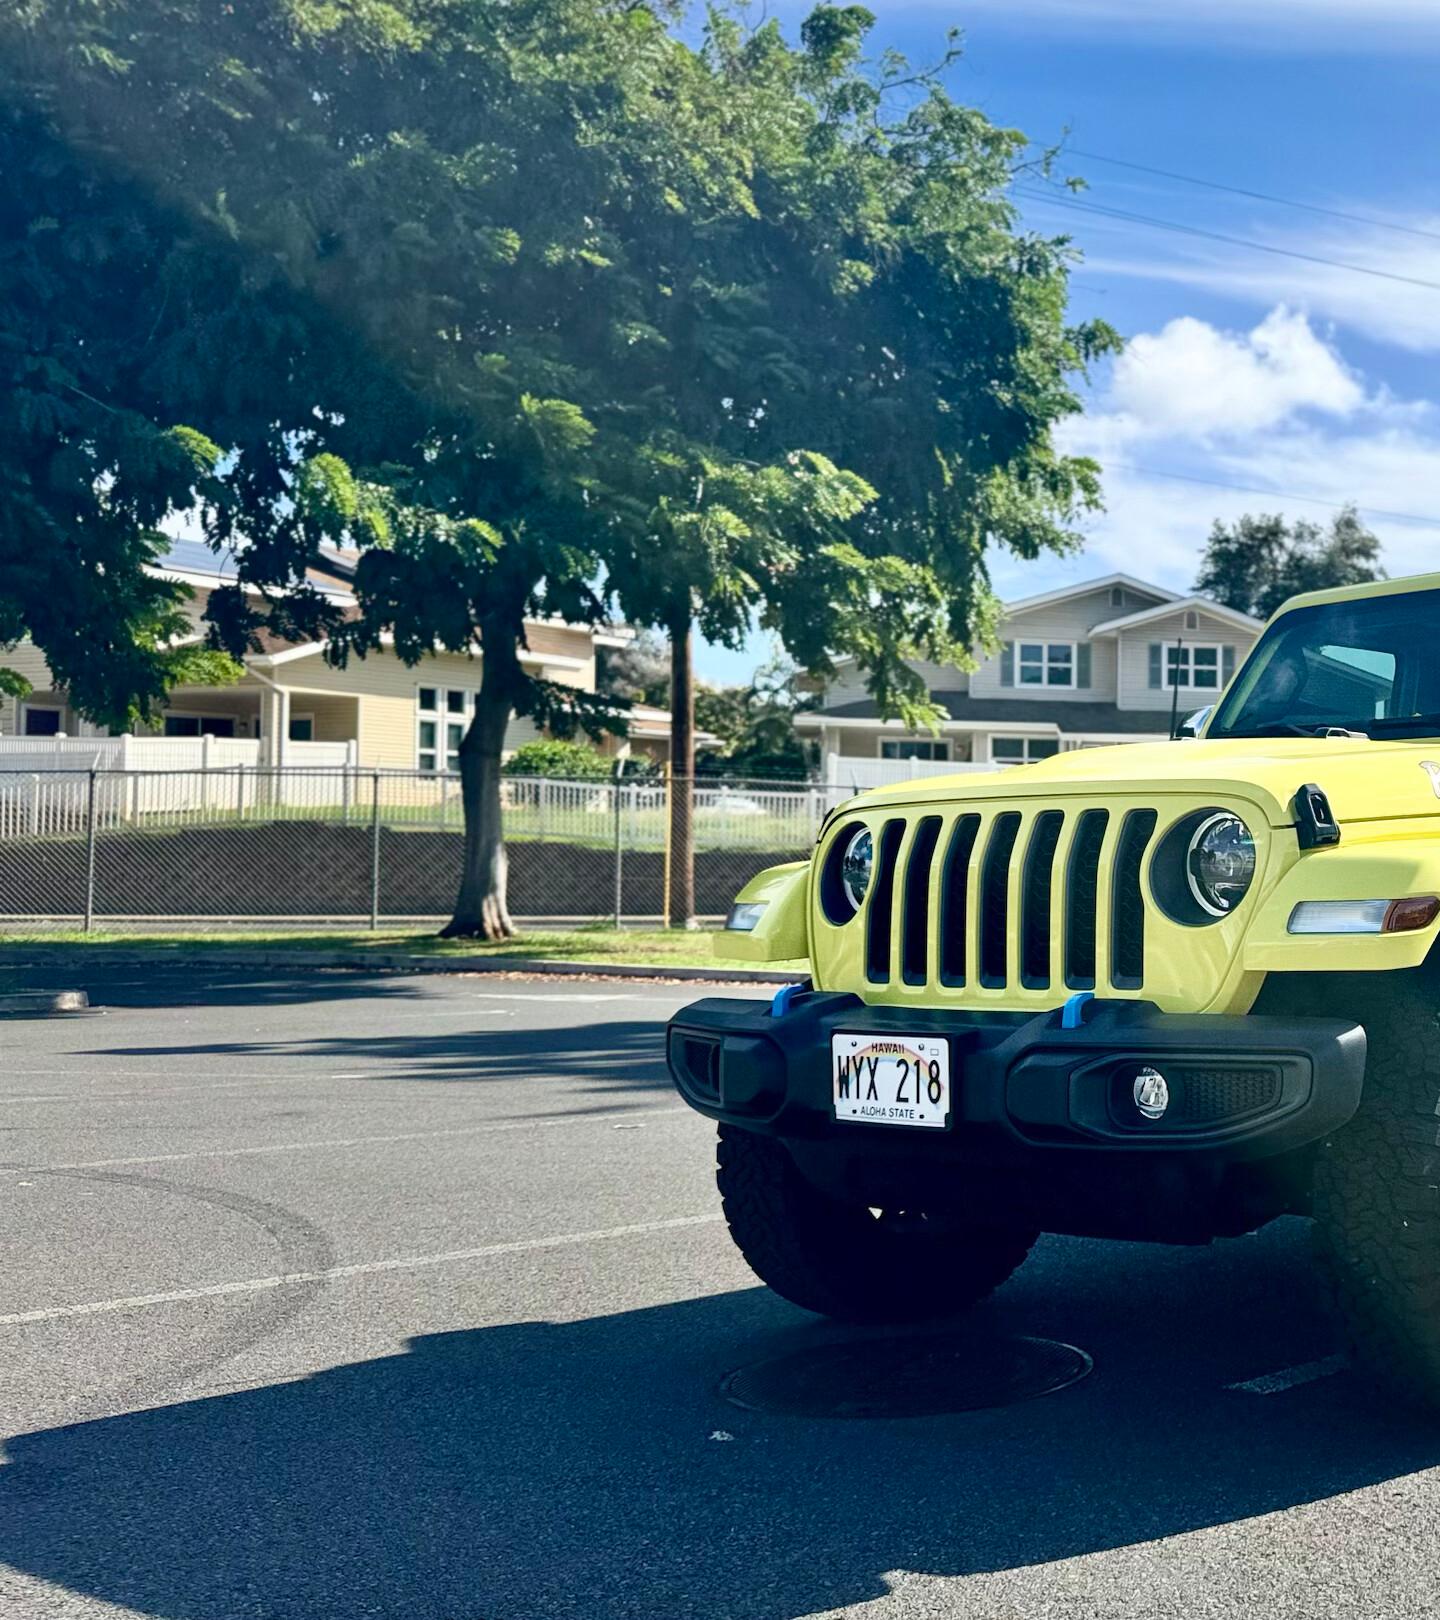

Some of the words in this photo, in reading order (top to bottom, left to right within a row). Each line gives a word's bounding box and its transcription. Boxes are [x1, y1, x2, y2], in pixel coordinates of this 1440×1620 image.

[871, 1043, 905, 1054] HAWAII
[838, 1055, 879, 1100] WYX
[896, 1058, 941, 1104] 218
[860, 1106, 886, 1116] ALOHA
[889, 1107, 915, 1119] STATE
